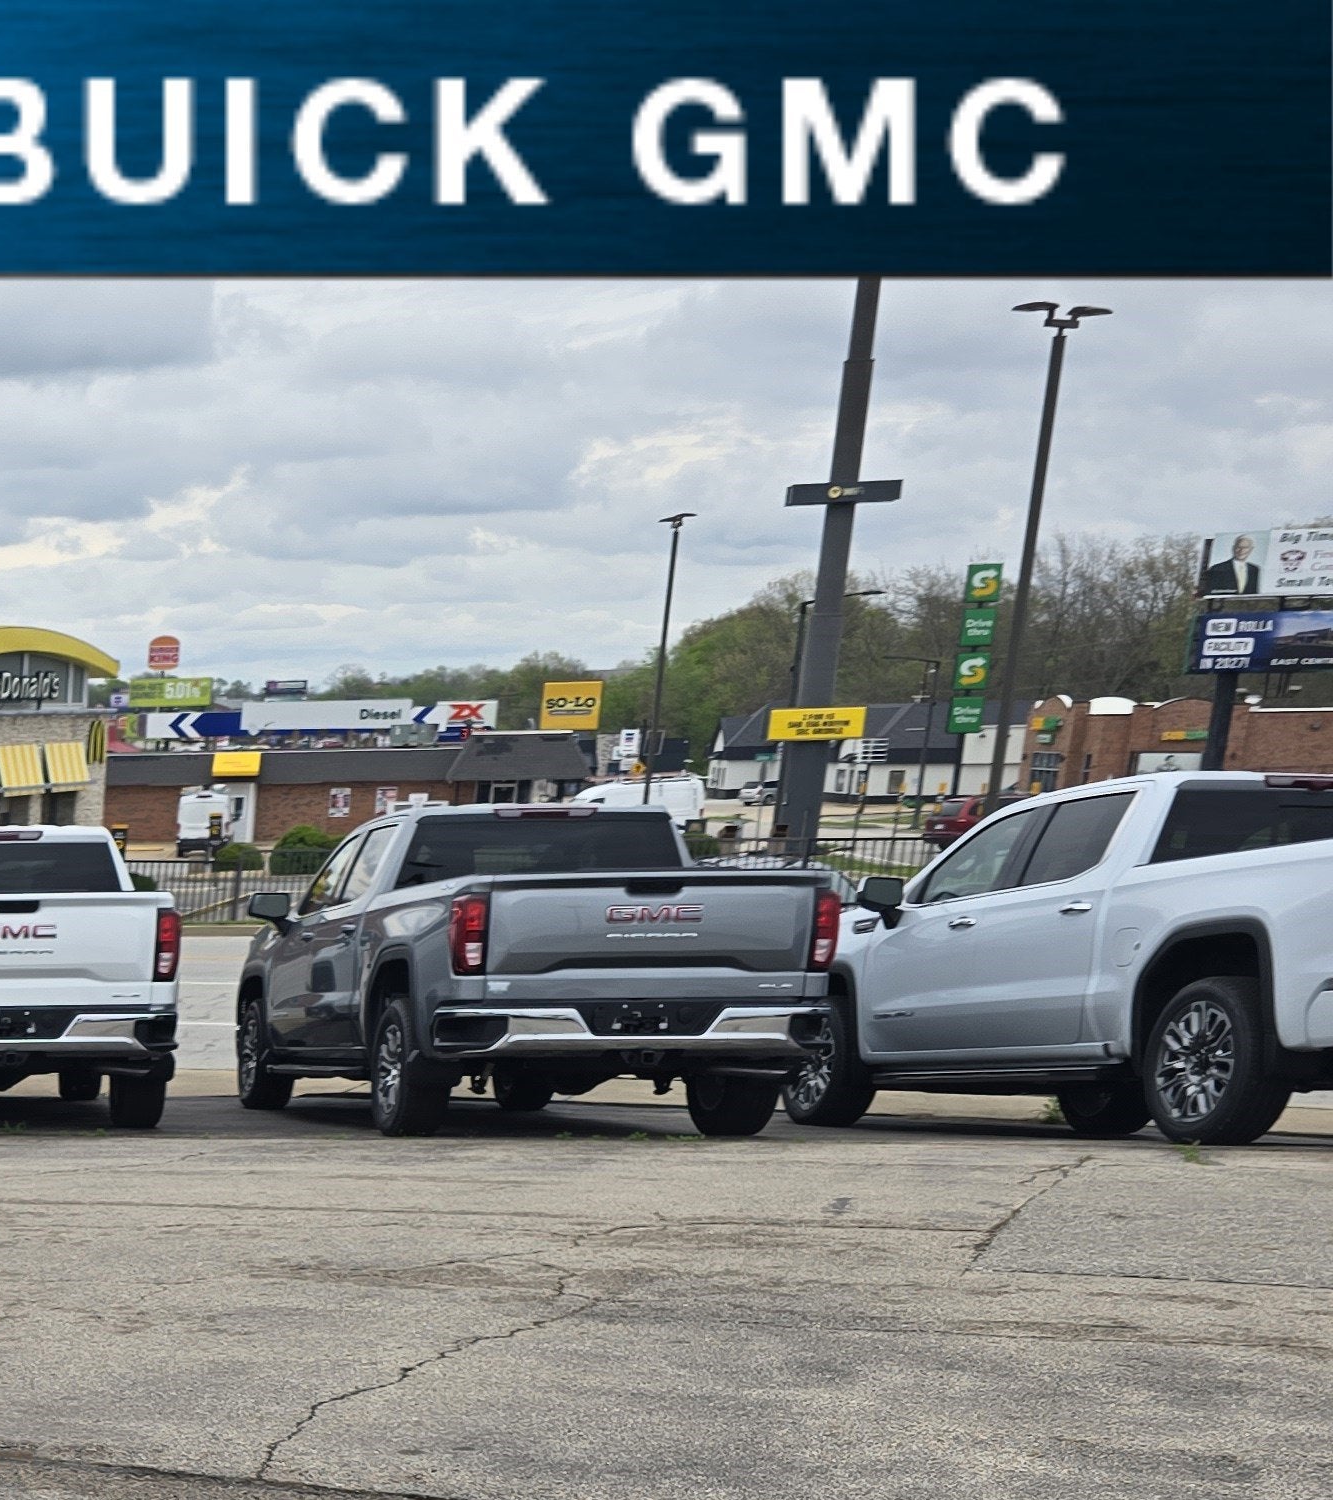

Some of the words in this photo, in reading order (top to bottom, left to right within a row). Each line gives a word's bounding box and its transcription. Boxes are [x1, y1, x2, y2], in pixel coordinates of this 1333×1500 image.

[966, 619, 994, 628] Drive
[546, 696, 596, 709] SO-LO
[359, 707, 402, 720] Diesel
[449, 704, 486, 720] ZX
[953, 706, 981, 716] Drive
[606, 904, 704, 924] GMC
